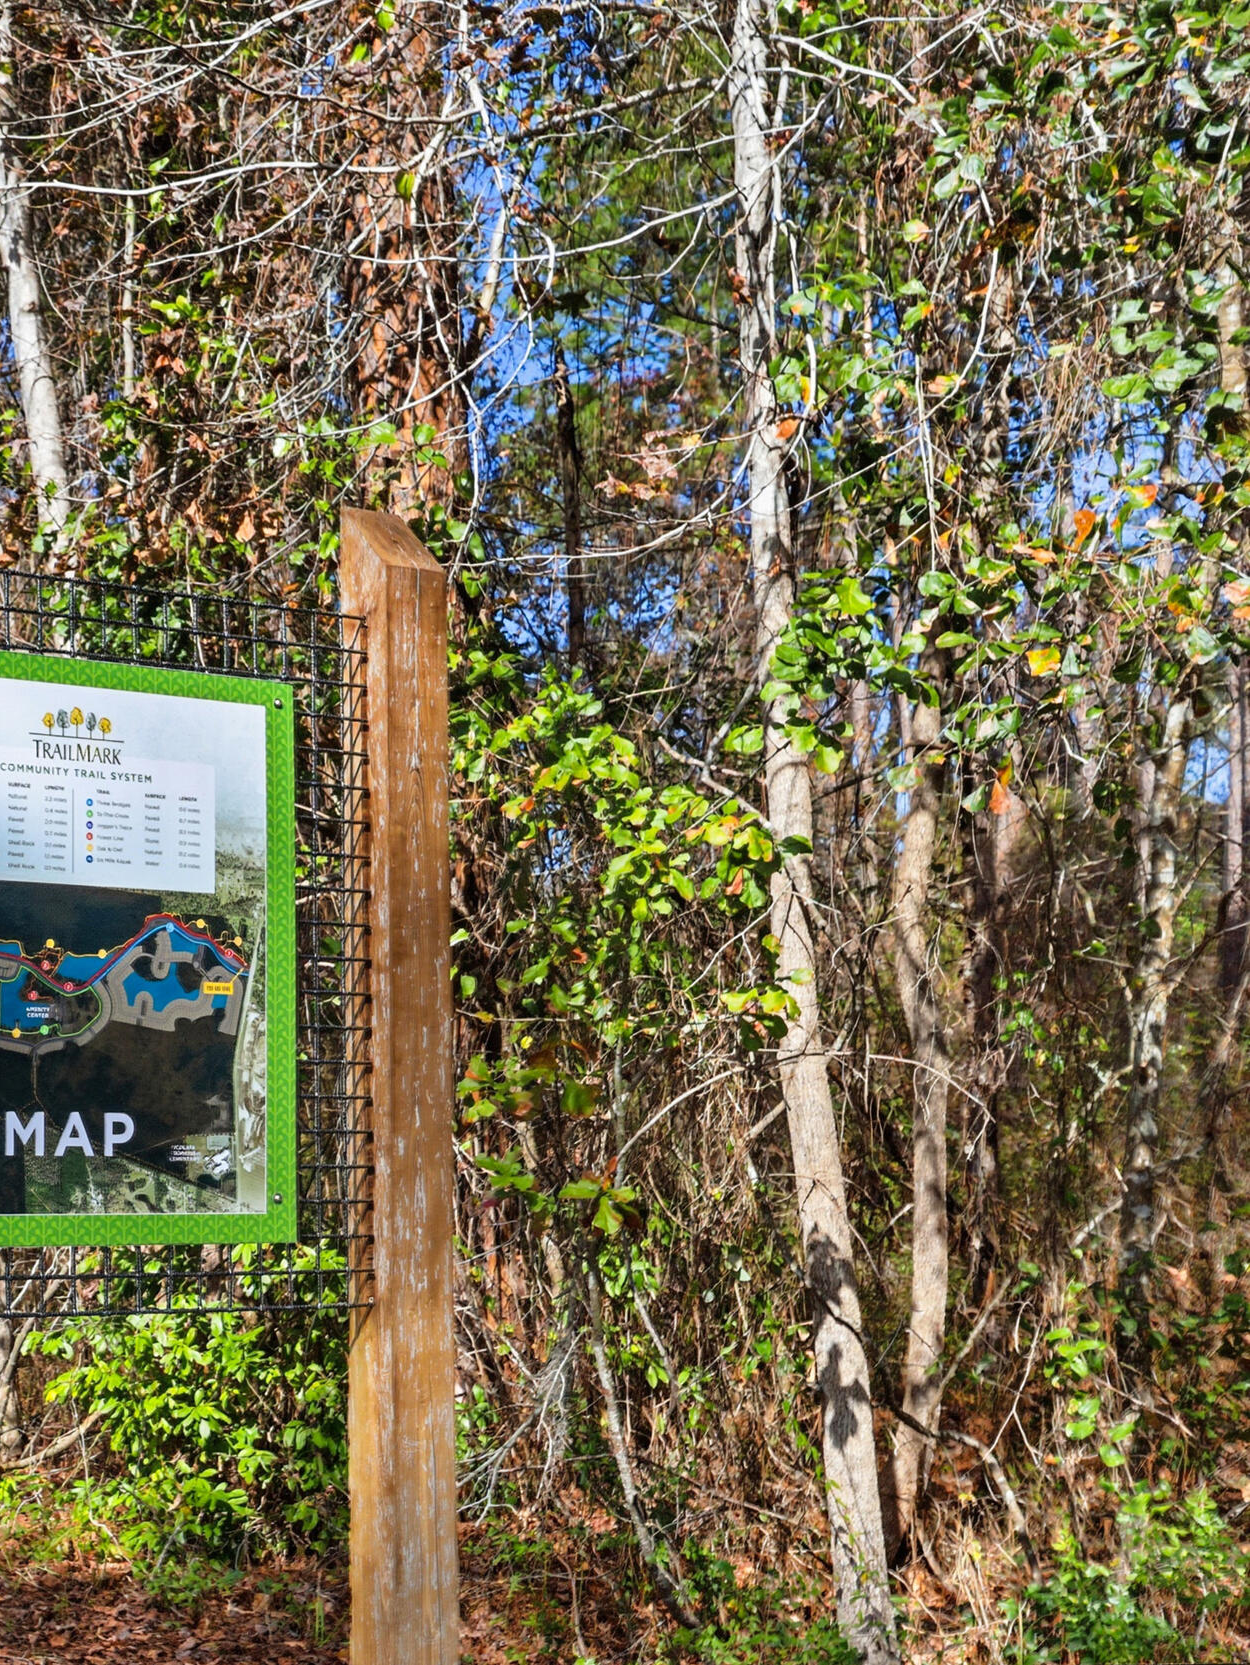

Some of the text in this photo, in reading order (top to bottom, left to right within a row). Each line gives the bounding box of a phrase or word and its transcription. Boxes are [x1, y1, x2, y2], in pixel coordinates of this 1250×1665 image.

[0, 762, 152, 783] COMMUNITY TRAIL SYSTEM
[5, 1111, 134, 1157] MAP
